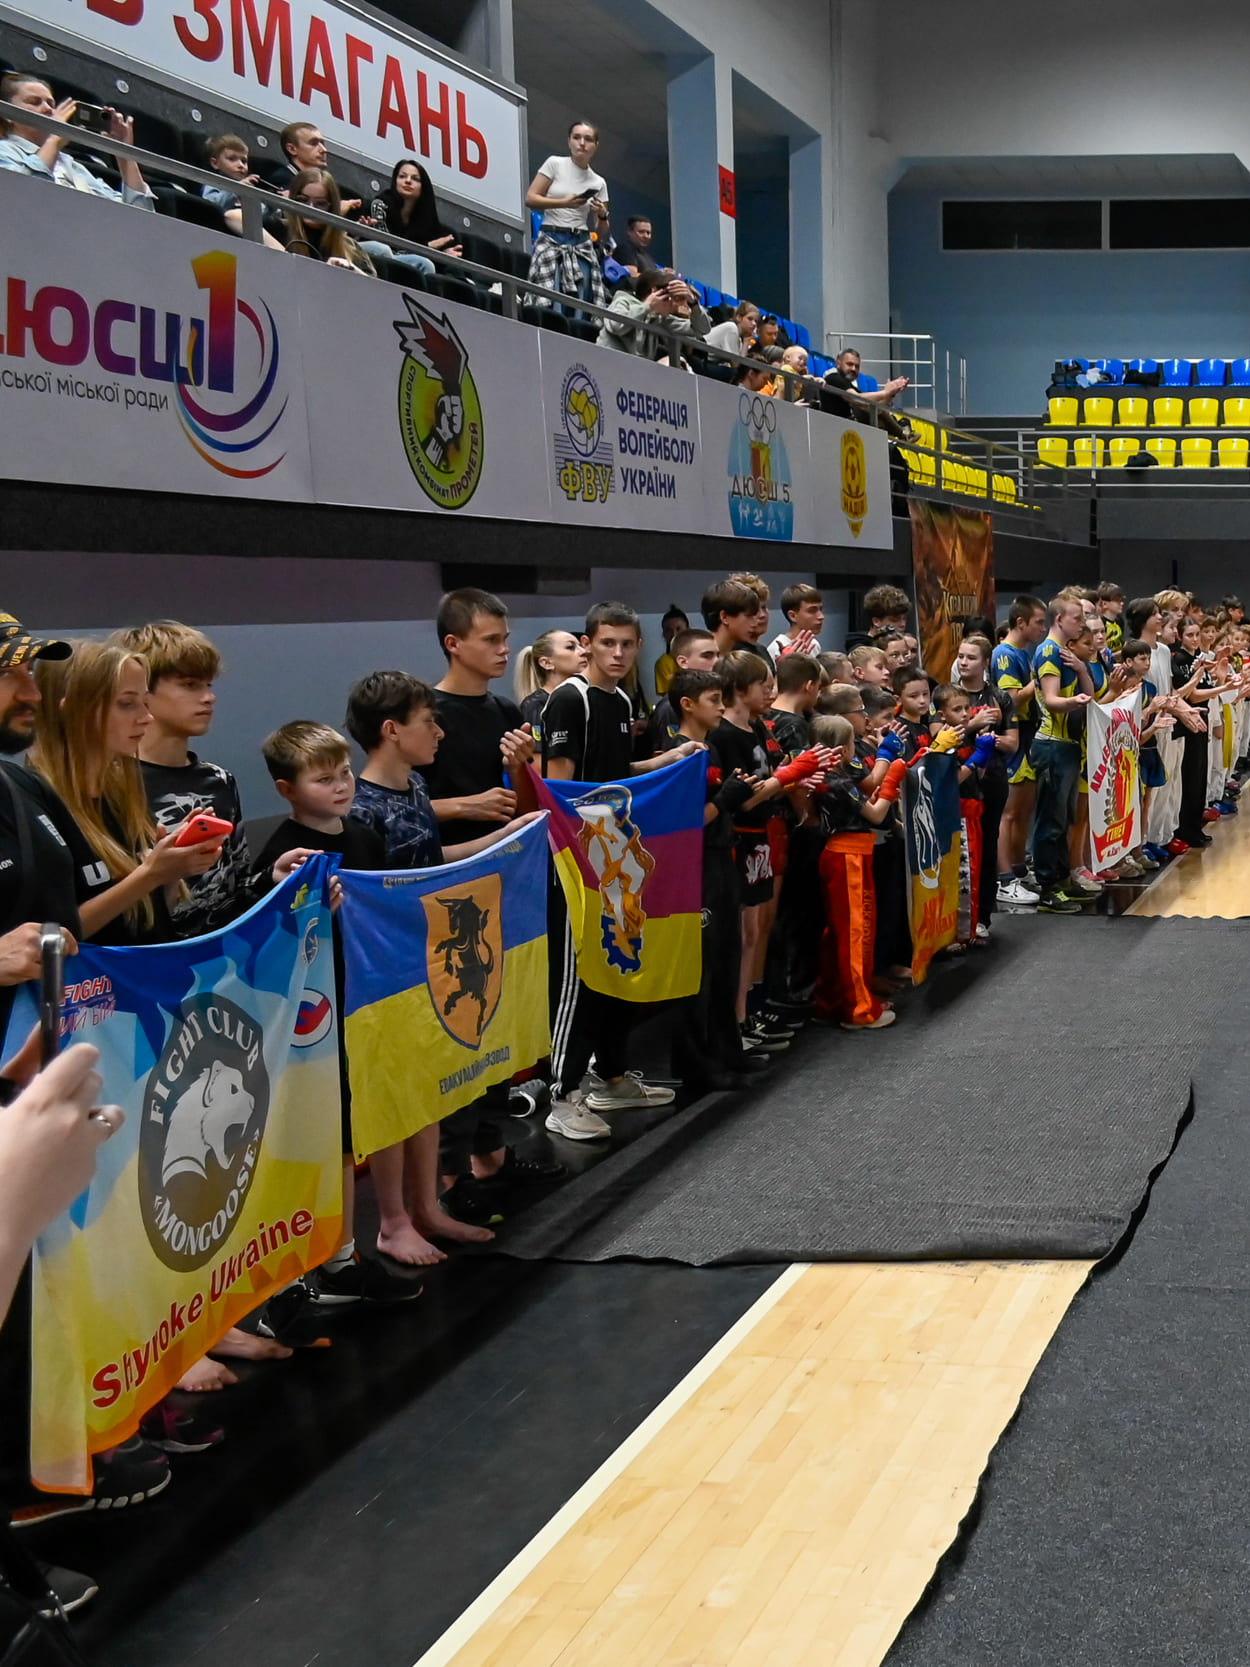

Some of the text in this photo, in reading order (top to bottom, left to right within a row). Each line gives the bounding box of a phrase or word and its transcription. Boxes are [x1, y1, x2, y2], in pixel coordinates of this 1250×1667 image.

[173, 0, 488, 180] ЗМАГАНЬ
[0, 369, 170, 412] ської міської ради
[616, 387, 689, 431] ФЕДЕРАЦІЯ
[449, 422, 479, 499] ПРОМЕТЕЙ
[618, 428, 695, 465] ВОЛЕЙБОЛУ
[559, 458, 613, 503] ФВУ
[620, 465, 676, 499] УКРАЇНИ
[149, 1005, 260, 1127] FIGHT CLUB
[210, 1208, 315, 1304] Ukraine
